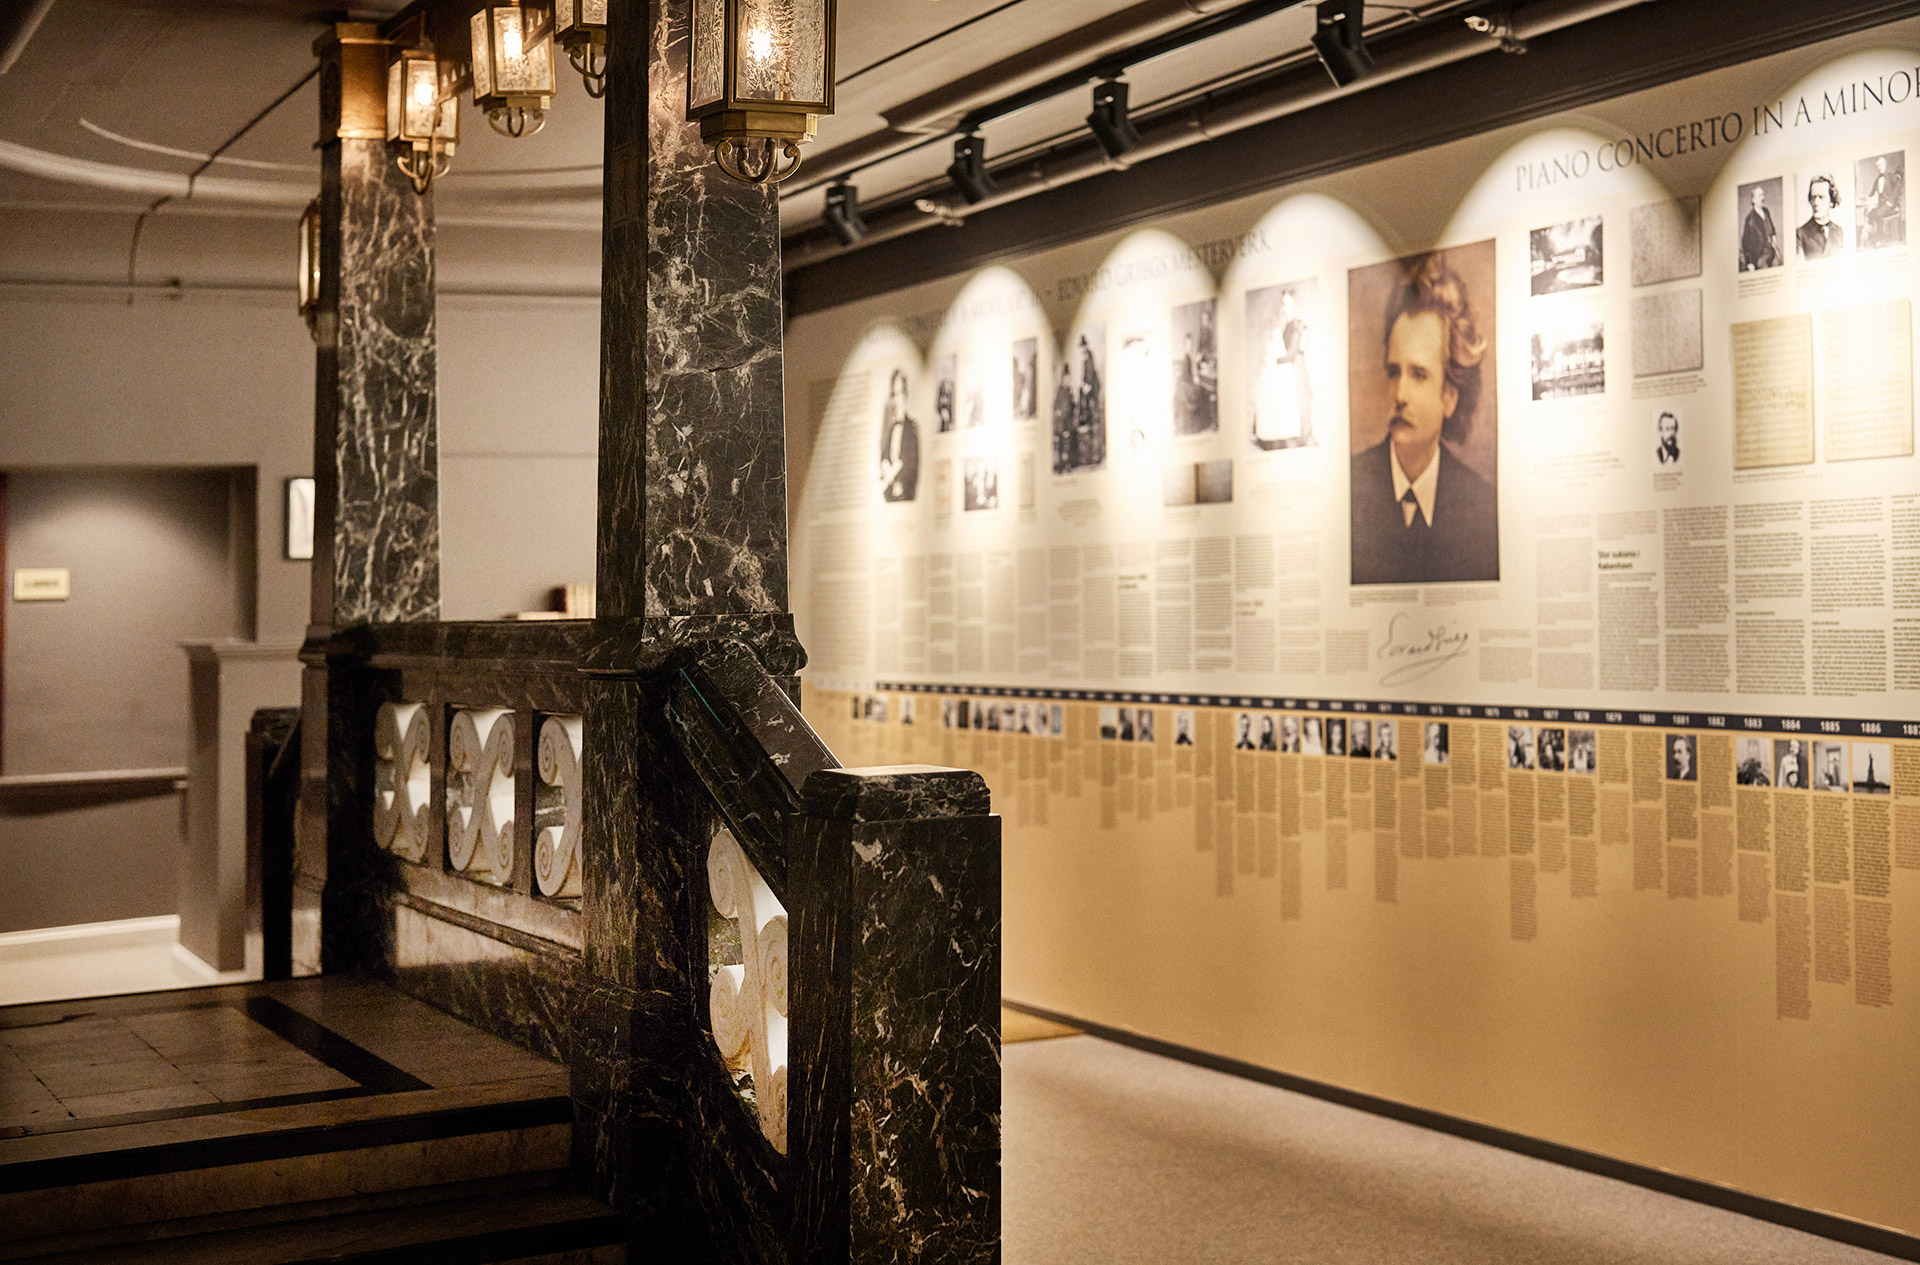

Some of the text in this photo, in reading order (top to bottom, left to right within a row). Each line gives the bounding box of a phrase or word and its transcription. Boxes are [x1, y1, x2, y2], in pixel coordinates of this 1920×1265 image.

[1516, 67, 1920, 192] PIANO CONCERTO IN A MINO
[1672, 714, 1690, 725] 1881
[1707, 716, 1725, 727] 1882
[1744, 717, 1762, 729] 1883
[1781, 719, 1801, 730] 1884
[1820, 721, 1840, 732] 1885
[1860, 722, 1881, 734] 1886
[1902, 724, 1920, 736] 188
